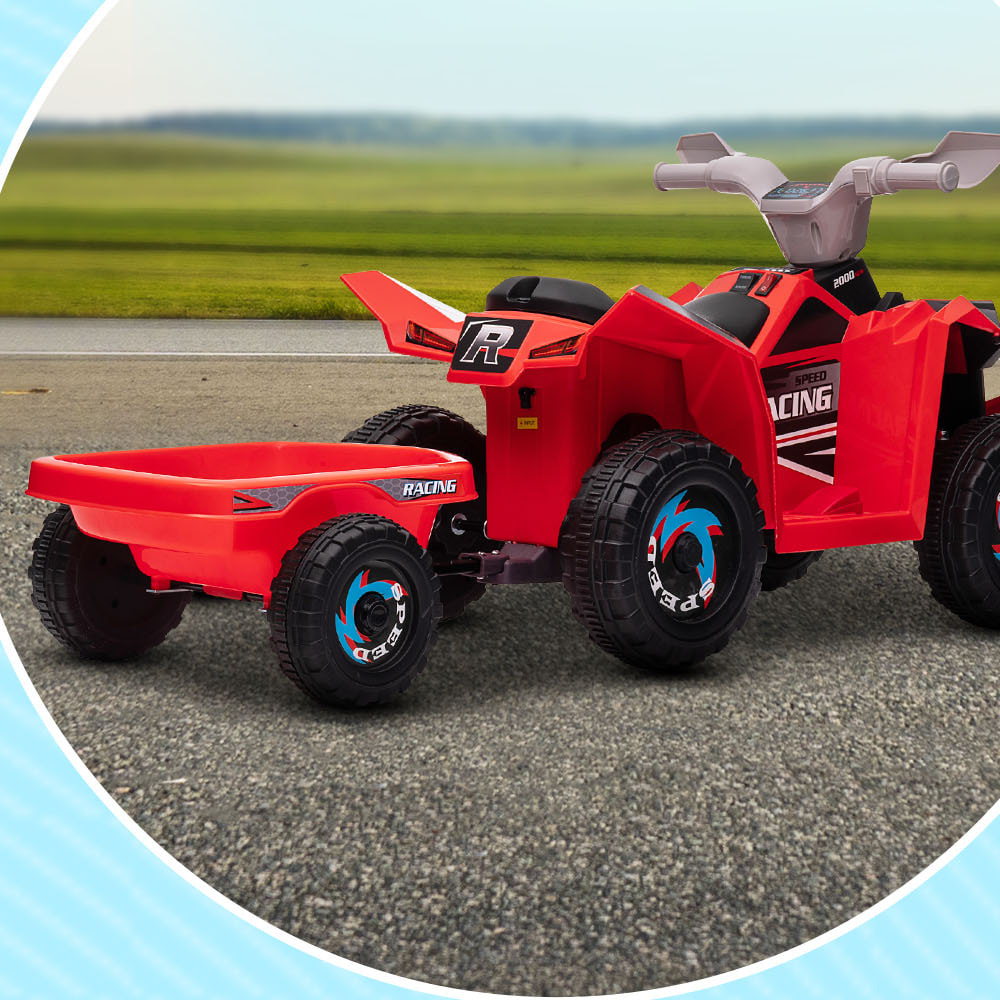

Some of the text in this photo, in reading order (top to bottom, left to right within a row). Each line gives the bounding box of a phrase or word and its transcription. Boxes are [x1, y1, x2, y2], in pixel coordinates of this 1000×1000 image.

[833, 269, 856, 289] 2000
[460, 324, 515, 365] R
[795, 371, 827, 386] SPEED
[403, 479, 457, 497] RACING
[648, 535, 715, 612] SPEED
[353, 582, 406, 662] SPEED
